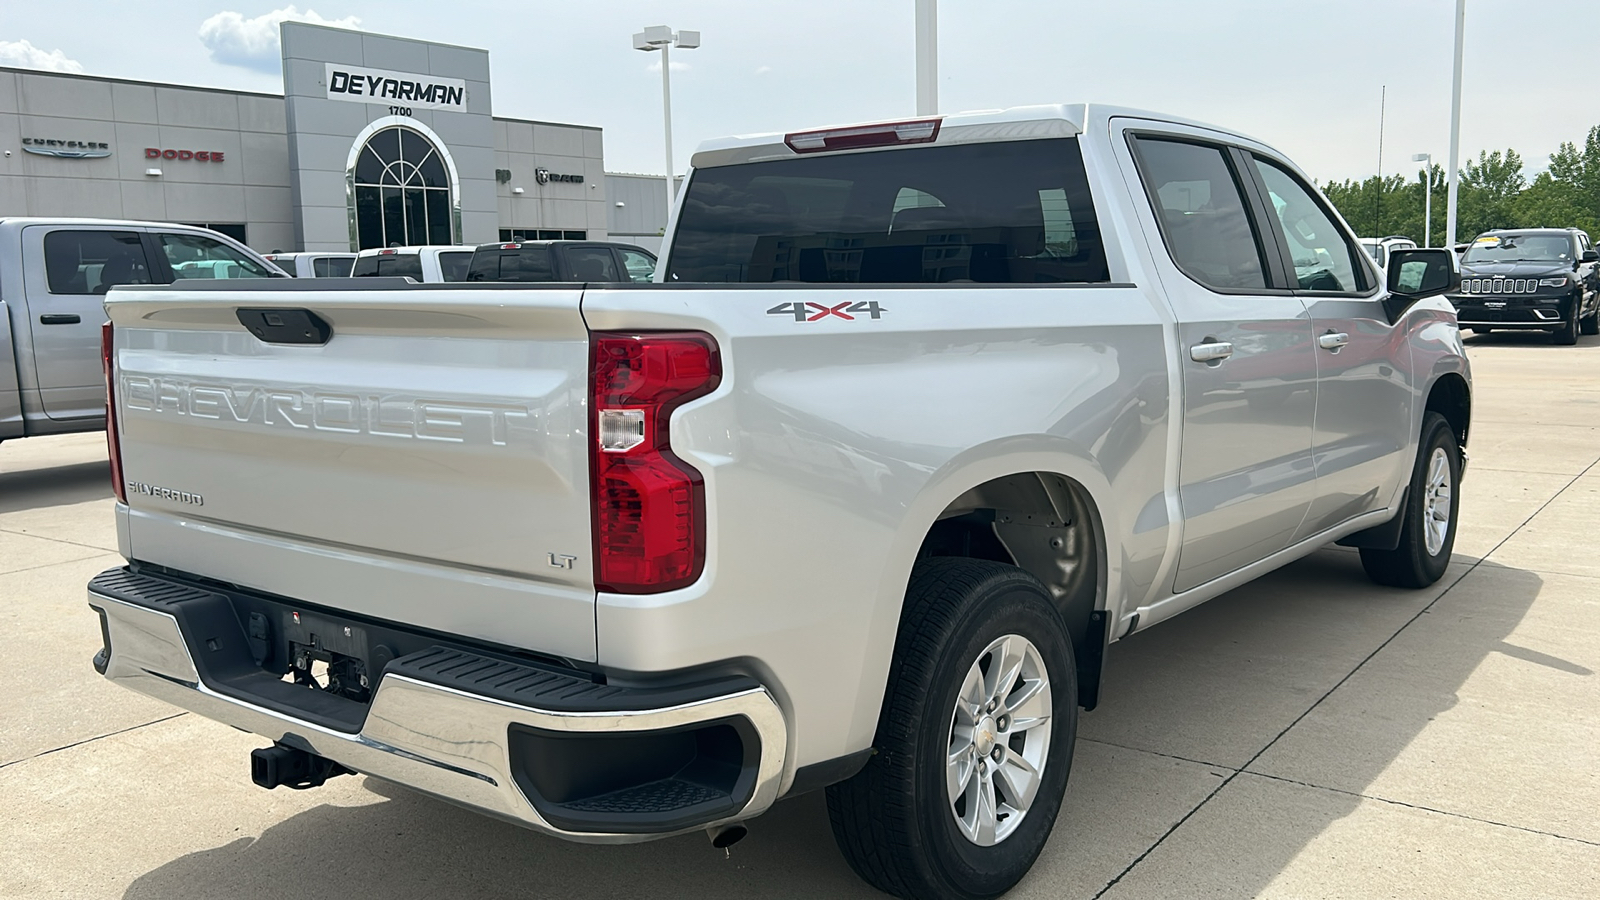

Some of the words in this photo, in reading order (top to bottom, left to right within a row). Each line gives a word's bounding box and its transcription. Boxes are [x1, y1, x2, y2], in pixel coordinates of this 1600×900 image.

[329, 71, 464, 105] DEYARMAN
[388, 106, 413, 117] 1700
[22, 137, 109, 149] CHRYSLER
[145, 148, 225, 162] DODGE
[549, 173, 584, 183] RAM
[123, 376, 529, 446] CHEVROLET
[128, 481, 204, 506] SILVERADO
[547, 552, 577, 570] LT
